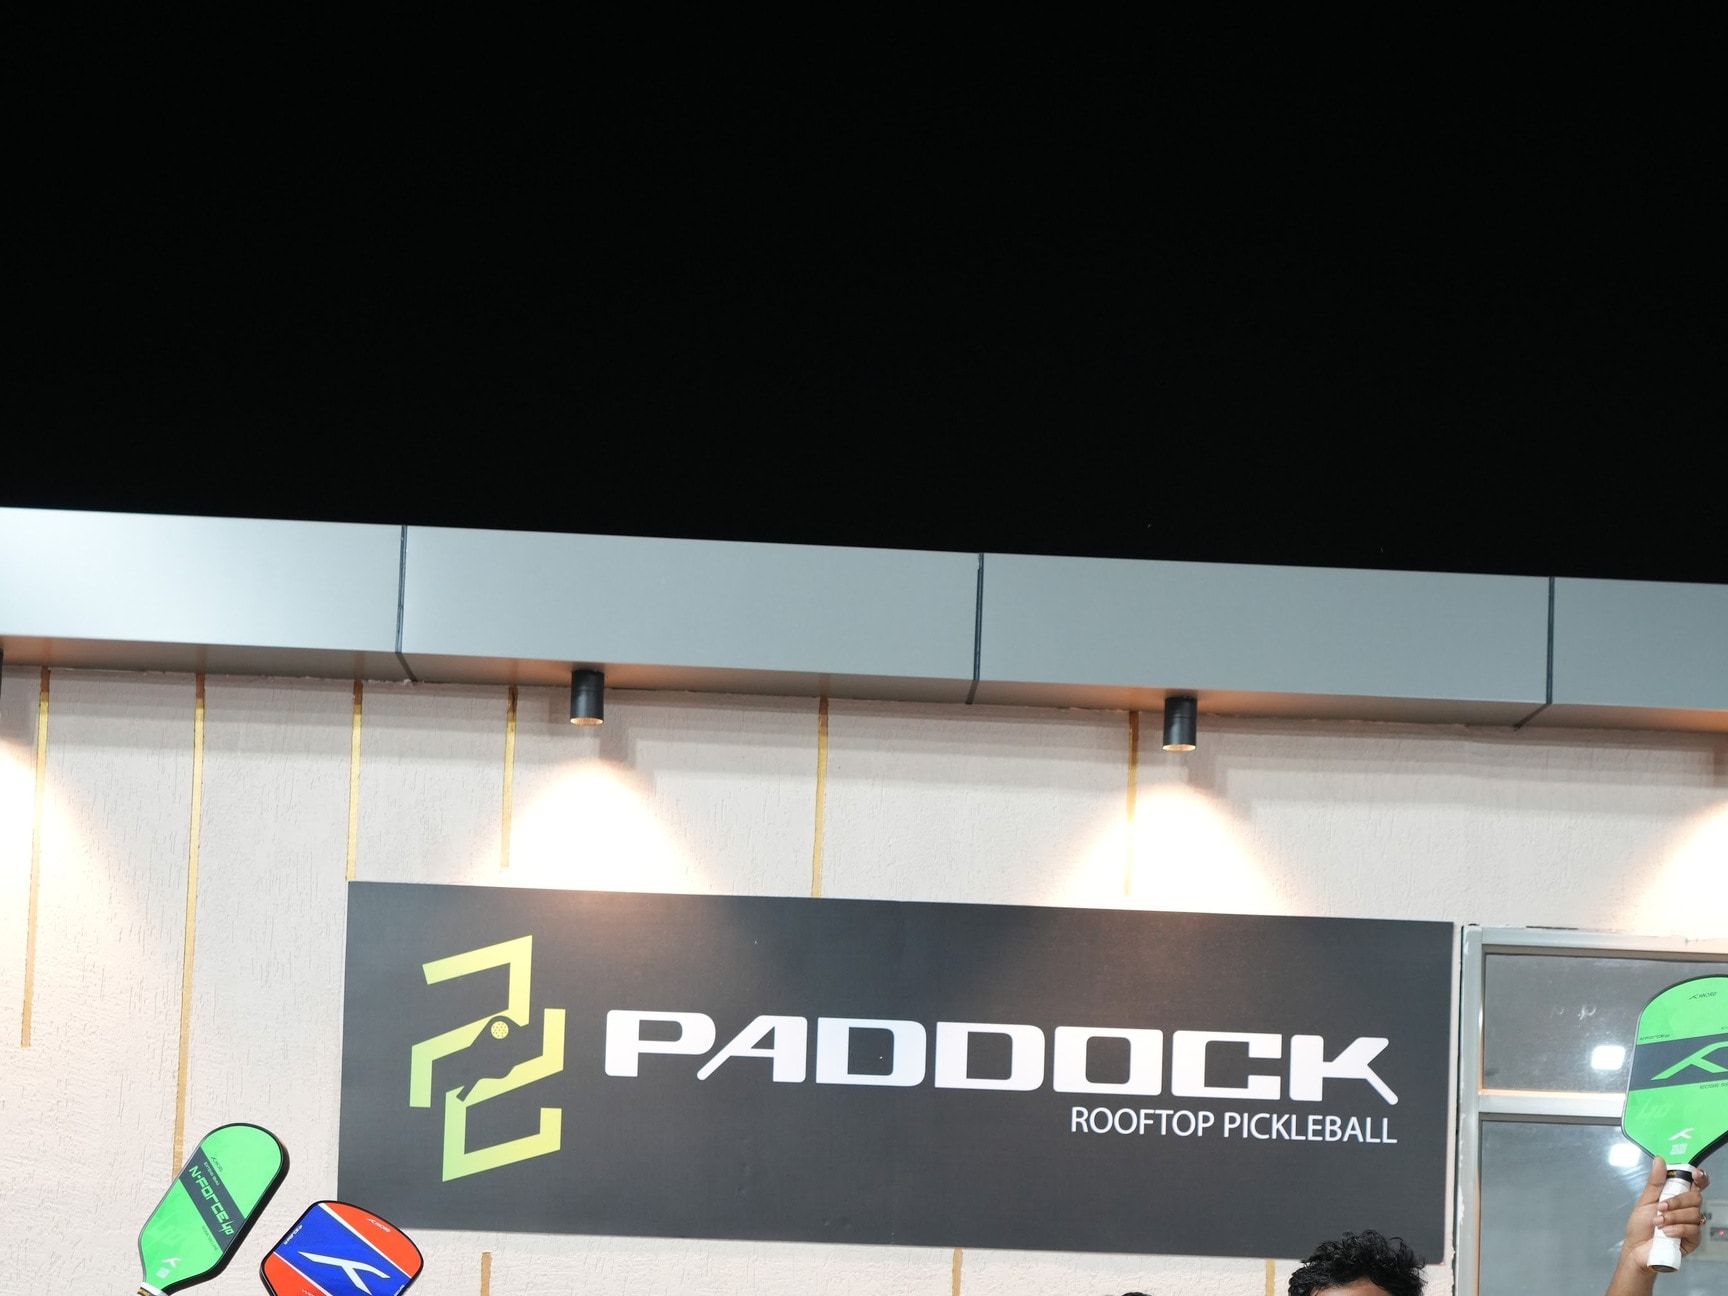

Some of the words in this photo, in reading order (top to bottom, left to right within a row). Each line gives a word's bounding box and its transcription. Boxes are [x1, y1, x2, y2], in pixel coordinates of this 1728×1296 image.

[605, 1010, 1399, 1105] PADDOCK
[1071, 1106, 1215, 1137] ROOFTOP
[1224, 1112, 1399, 1144] PICKLEBALL
